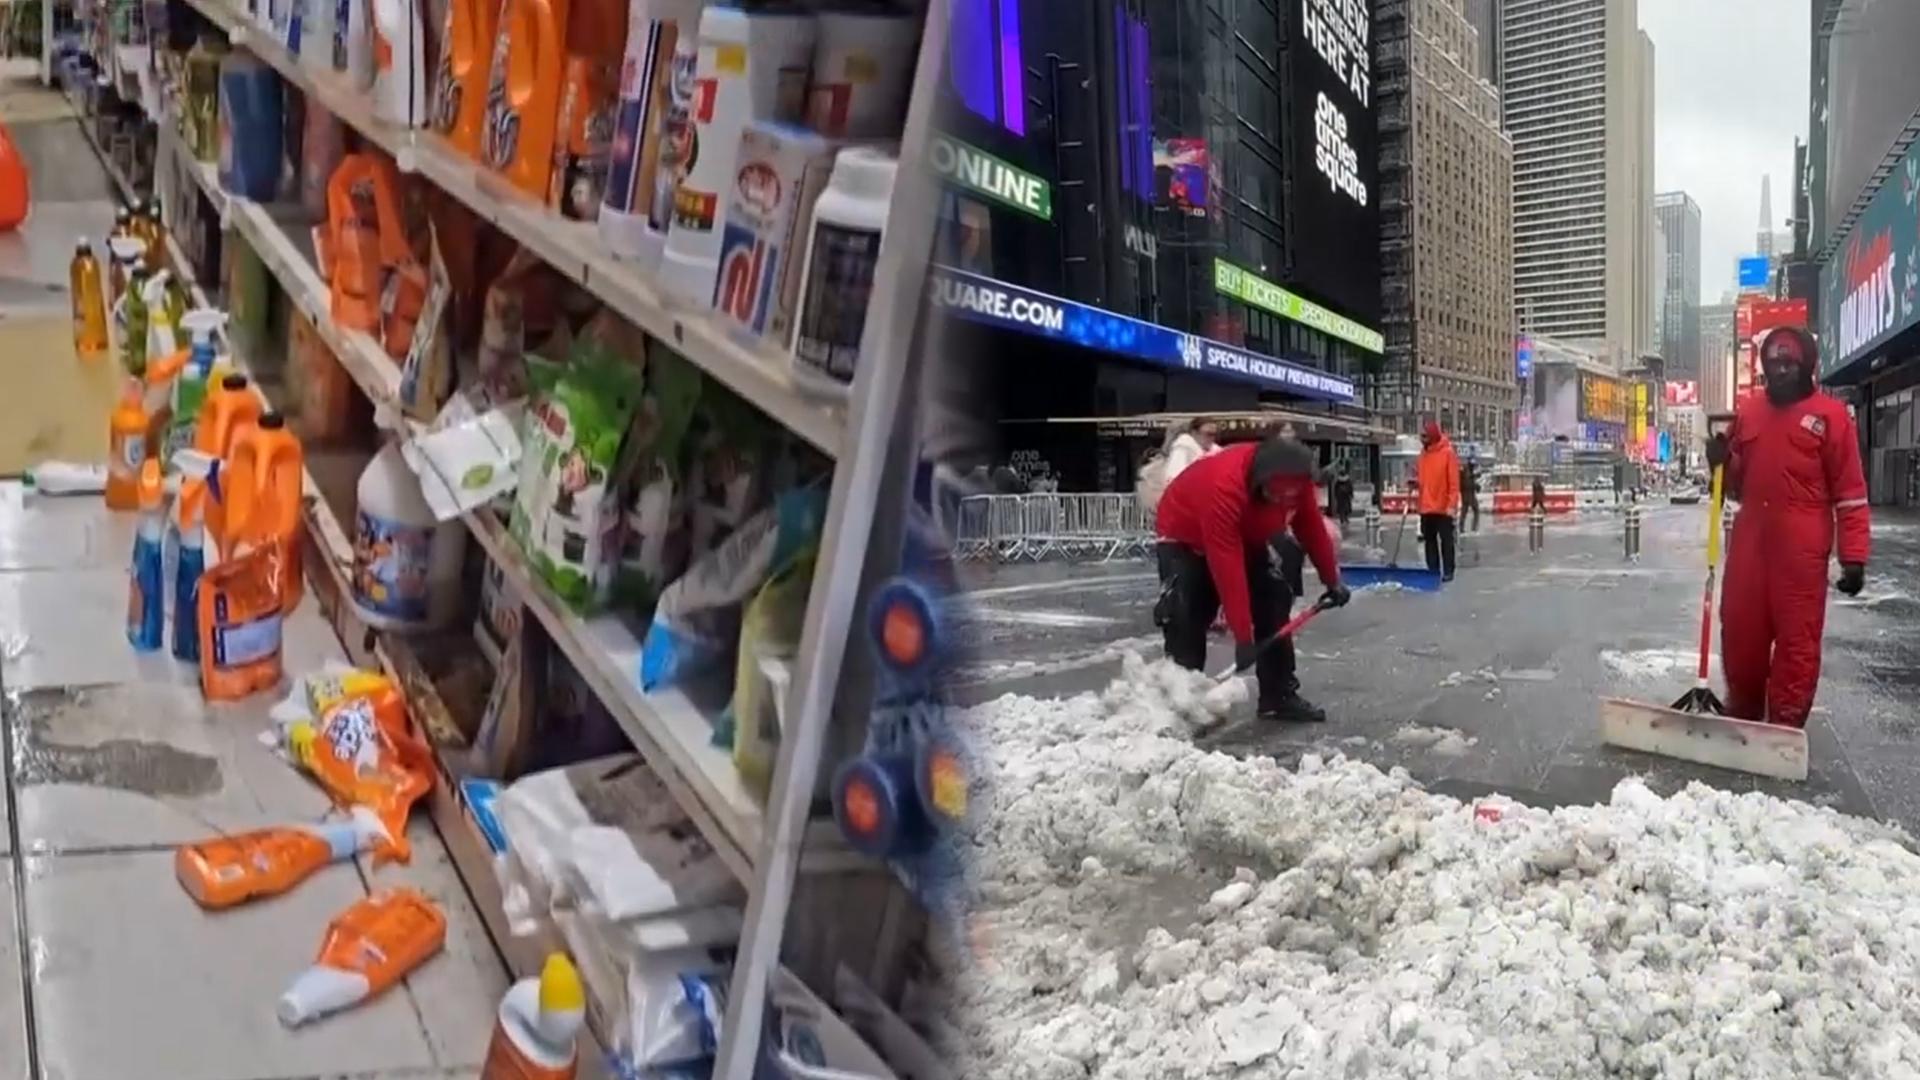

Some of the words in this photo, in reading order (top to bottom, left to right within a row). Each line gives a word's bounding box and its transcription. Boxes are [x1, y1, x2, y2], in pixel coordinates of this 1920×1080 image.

[1303, 0, 1347, 85] HERE
[1350, 62, 1370, 108] AT
[1314, 109, 1358, 174] times
[1317, 91, 1348, 139] one
[930, 137, 1042, 211] ONLINE
[1315, 143, 1367, 206] square
[1207, 347, 1249, 374] SPECIAL
[1250, 358, 1287, 381] HOLIDAY
[1287, 369, 1319, 389] PREVIEW
